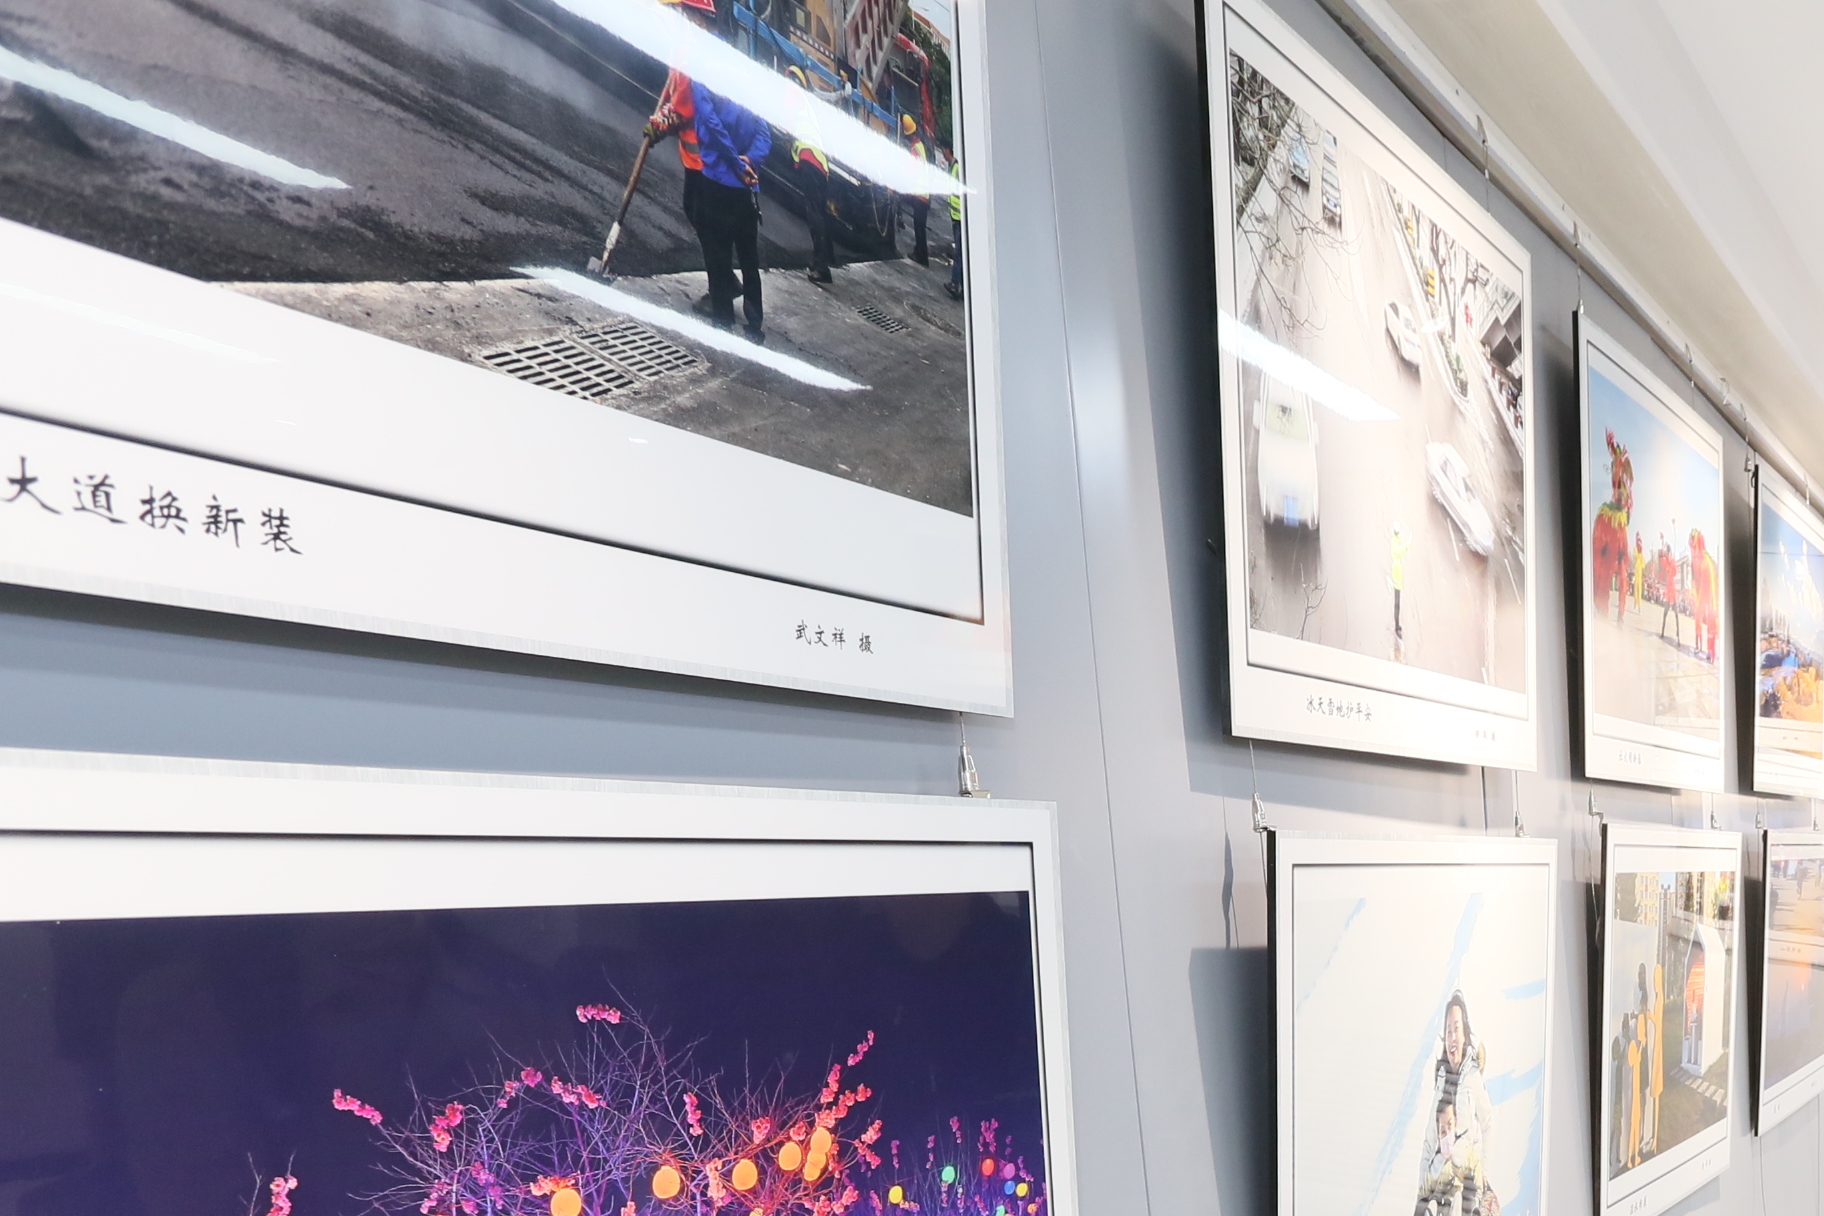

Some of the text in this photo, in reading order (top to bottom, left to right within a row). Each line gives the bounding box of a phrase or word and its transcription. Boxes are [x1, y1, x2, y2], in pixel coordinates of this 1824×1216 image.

[0, 455, 303, 555] 大道换新装
[795, 619, 874, 654] 武文祥 摄
[1306, 695, 1372, 722] 冰天雪地护平安
